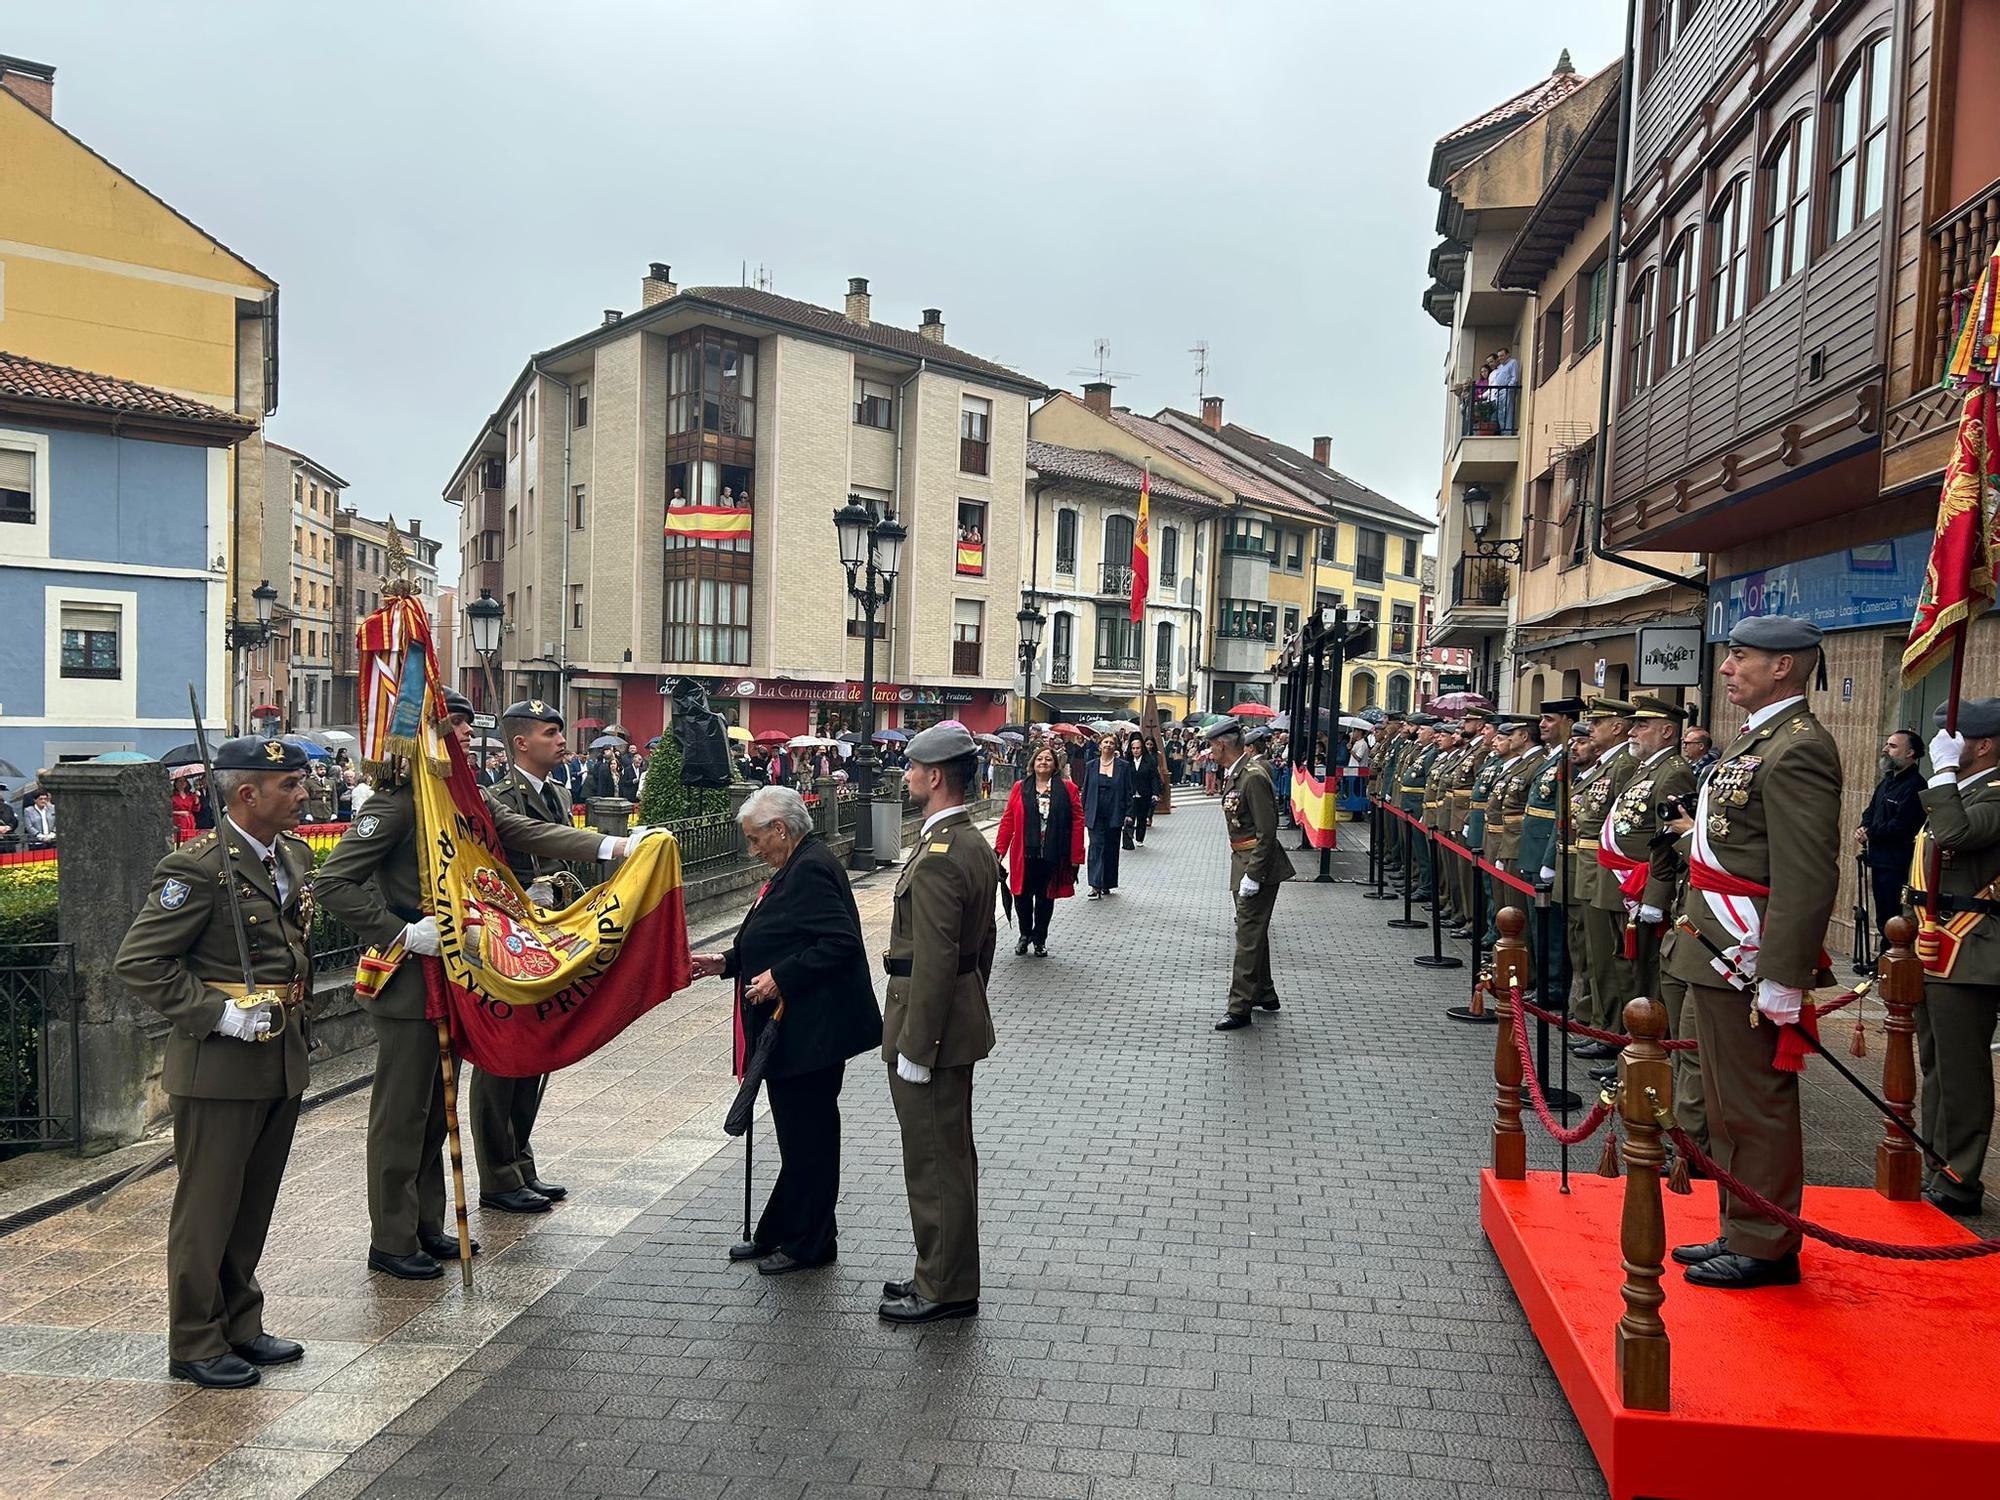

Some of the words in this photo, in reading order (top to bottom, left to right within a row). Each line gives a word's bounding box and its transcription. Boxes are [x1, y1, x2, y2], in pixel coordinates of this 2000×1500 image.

[1839, 604, 1861, 617] Locales
[1861, 598, 1898, 614] Comerciales
[758, 687, 775, 698] La
[848, 686, 861, 700] de
[536, 894, 624, 1021] PRINCIPE
